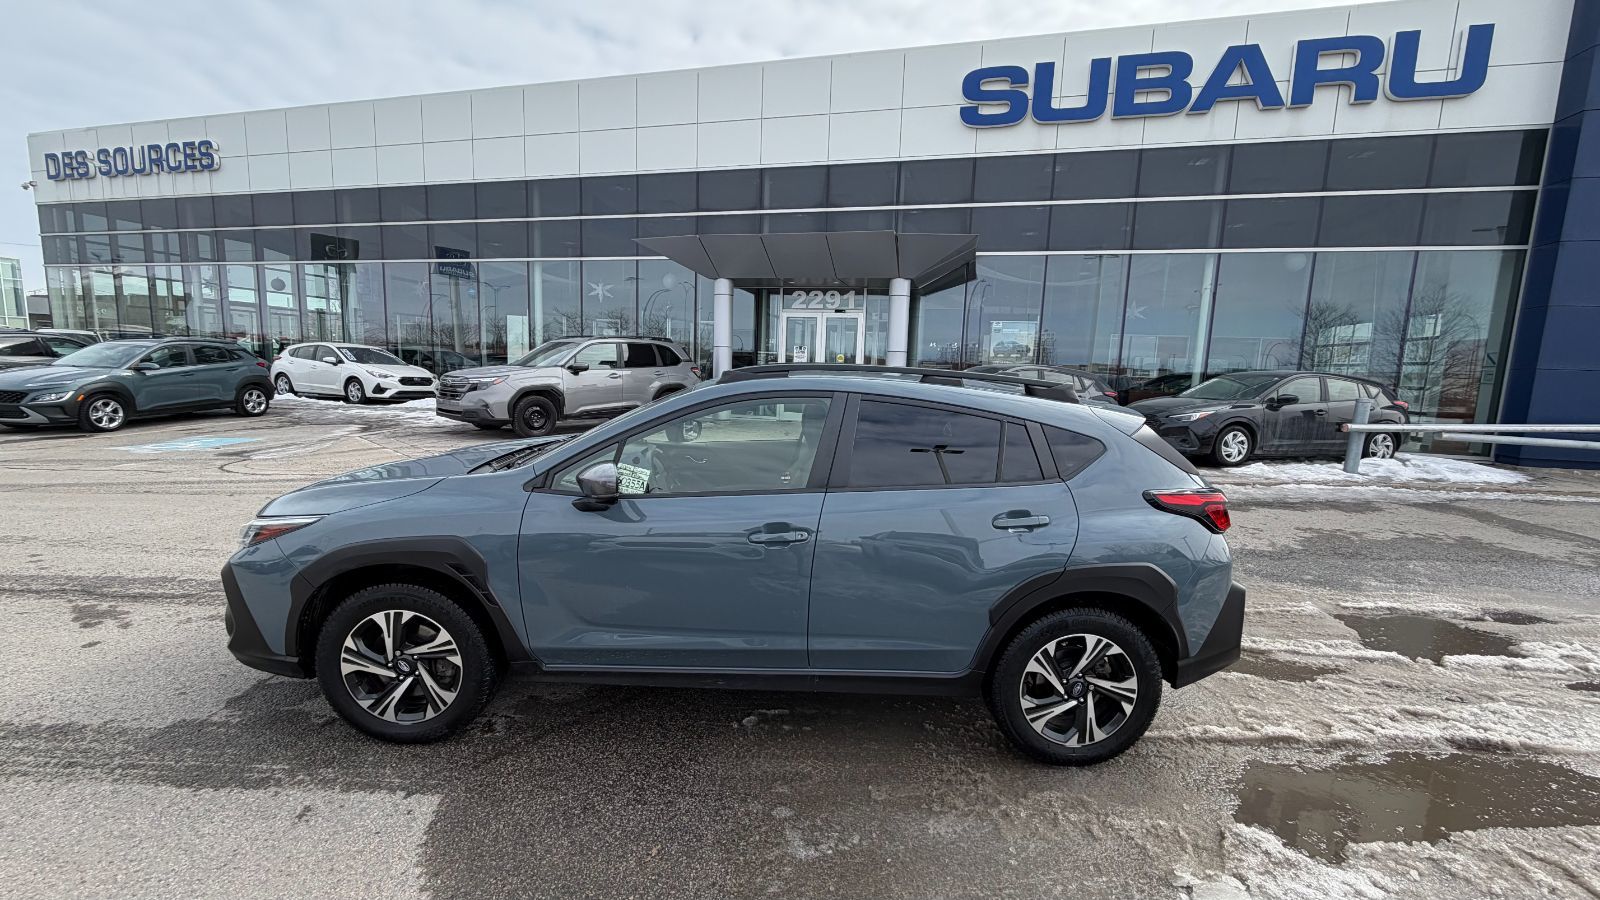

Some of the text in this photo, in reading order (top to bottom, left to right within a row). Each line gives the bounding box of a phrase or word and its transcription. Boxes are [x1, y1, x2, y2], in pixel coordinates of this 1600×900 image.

[960, 23, 1495, 128] SUBARU
[44, 139, 217, 180] DES SOURCES
[791, 290, 856, 309] 2291
